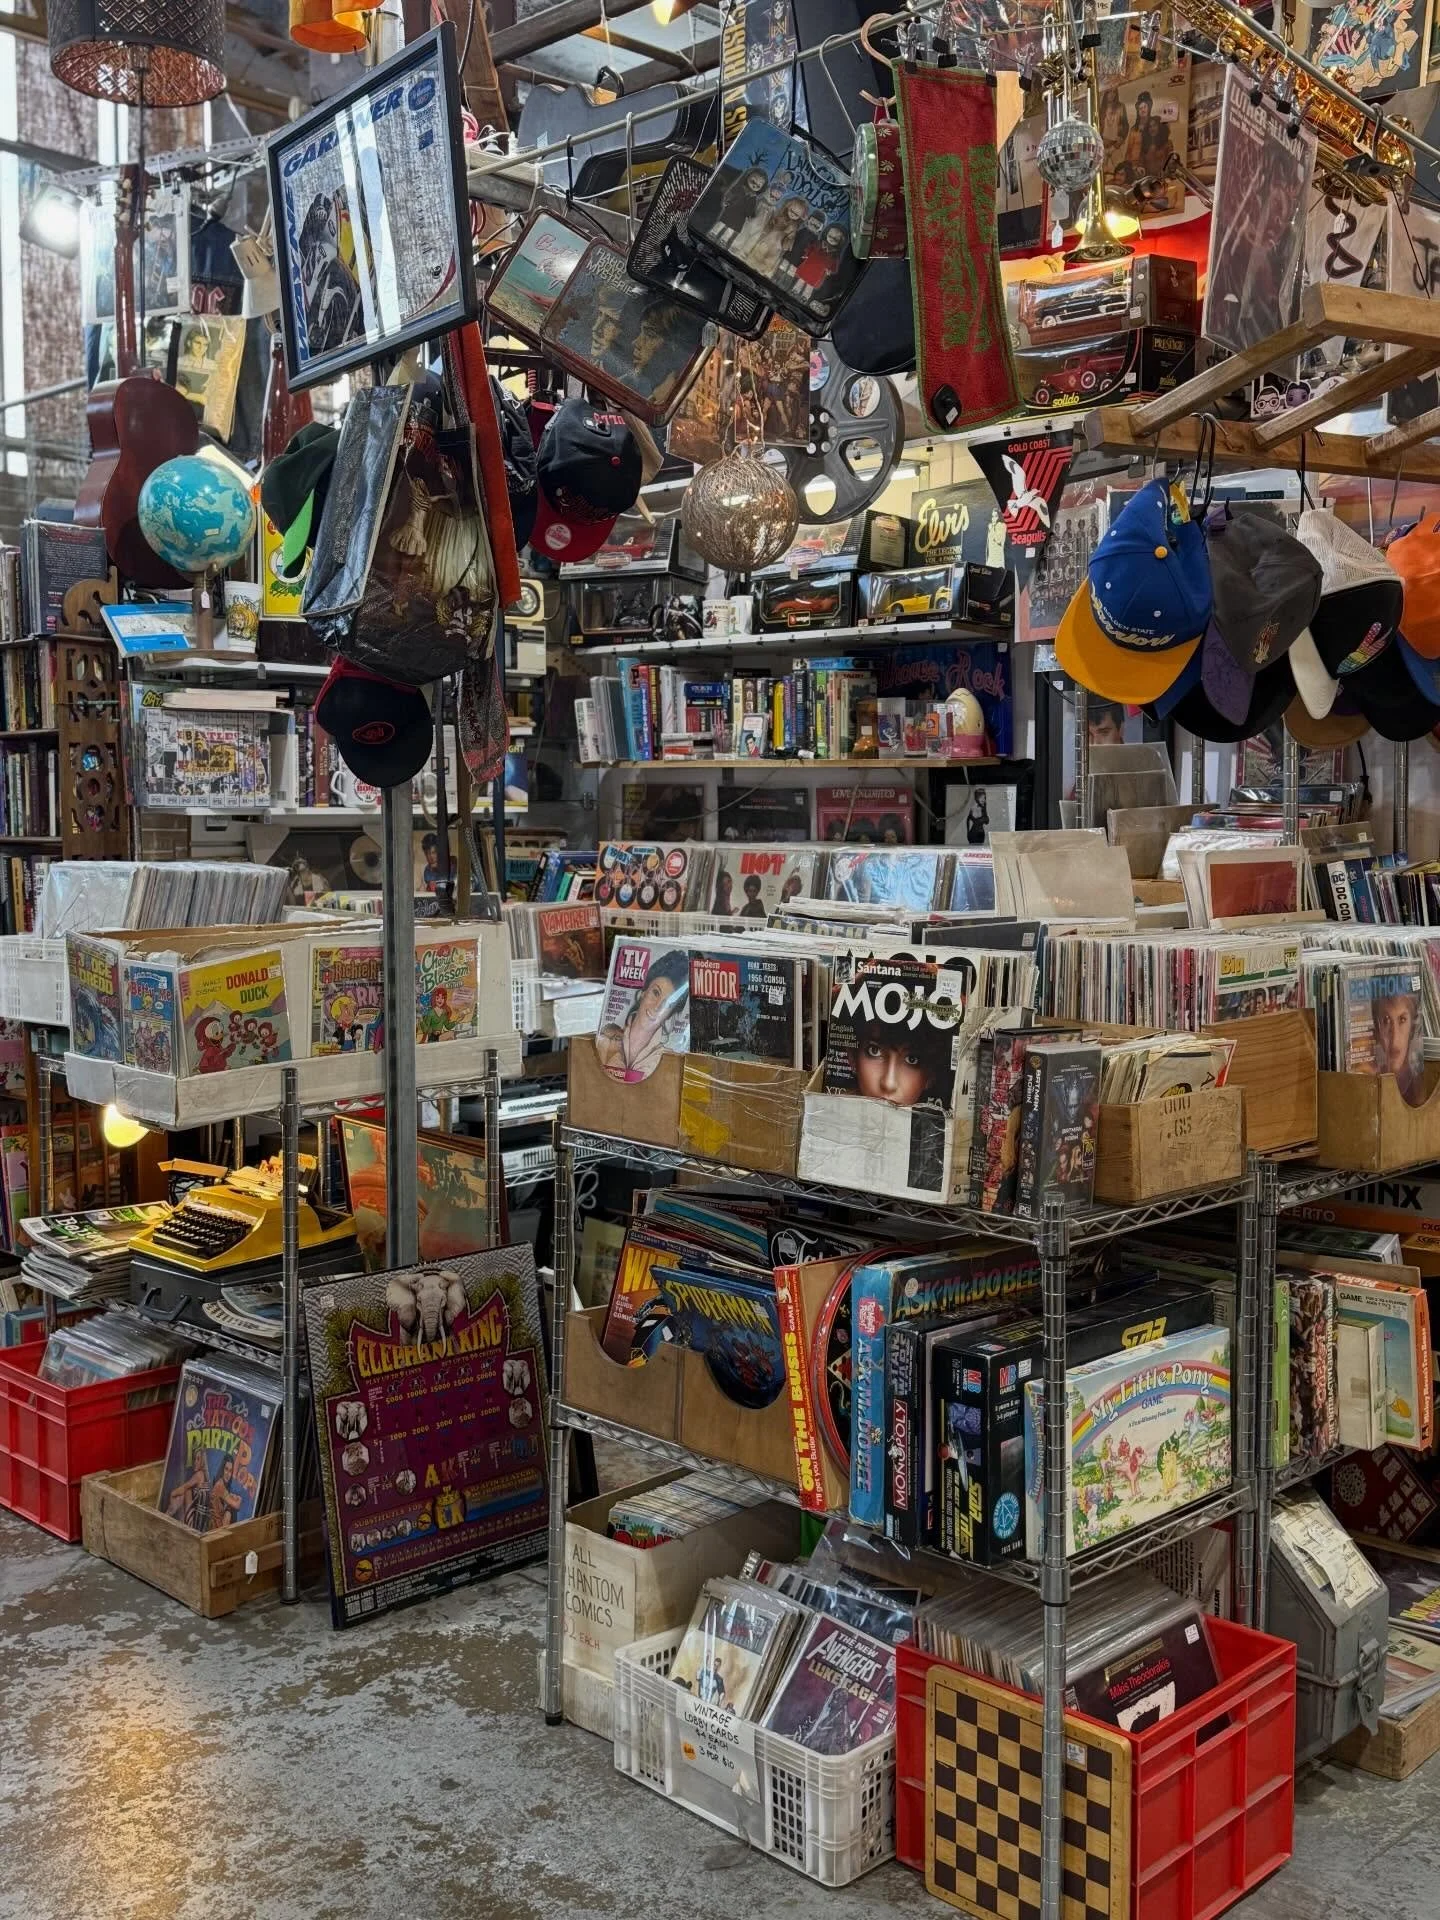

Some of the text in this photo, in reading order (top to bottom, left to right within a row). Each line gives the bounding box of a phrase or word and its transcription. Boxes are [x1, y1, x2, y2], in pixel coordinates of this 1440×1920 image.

[790, 173, 830, 210] DOLLS
[1153, 338, 1186, 351] PRESTIGE
[1052, 393, 1081, 408] solido
[1008, 439, 1028, 451] GOLD
[915, 498, 970, 553] Elvis
[1011, 531, 1046, 546] Seagulls
[1103, 606, 1155, 635] GOLDEN STATE
[945, 647, 1005, 700] Rock
[832, 788, 855, 799] LOVE
[739, 852, 786, 876] HOT
[1336, 886, 1348, 900] DC
[421, 948, 457, 973] Cheryl
[622, 949, 648, 966] TV
[693, 959, 720, 969] modern
[856, 961, 901, 977] Santana
[1221, 955, 1245, 976] Big
[79, 971, 114, 996] DREDD
[202, 977, 222, 988] WALT
[226, 967, 269, 989] DONALD
[420, 965, 470, 993] Blossom
[620, 966, 645, 981] WEEK
[694, 967, 738, 999] MOTOR
[747, 974, 787, 985] 1956 CONSUL
[239, 984, 270, 1004] DUCK
[747, 984, 760, 992] AND
[831, 980, 964, 1031] MOJO
[1033, 1069, 1042, 1112] BATMAN
[1062, 1126, 1083, 1135] BATMAN
[1018, 1203, 1032, 1215] PG
[615, 1300, 633, 1310] GUIDE
[617, 1294, 629, 1302] THE
[895, 1280, 939, 1319] ASK
[1339, 1292, 1363, 1302] GAME
[615, 1306, 623, 1314] TO
[787, 1305, 797, 1332] GAME
[356, 1317, 504, 1377] ELEPHANT KING
[888, 1331, 901, 1387] STAR
[784, 1332, 803, 1401] BUSES
[857, 1338, 873, 1384] ASK
[898, 1332, 910, 1396] WARS
[386, 1370, 497, 1405] 5000 10000 15000 25000 50000
[967, 1369, 982, 1394] MB
[1000, 1365, 1017, 1387] MB
[1000, 1385, 1016, 1394] GAMES
[1089, 1362, 1213, 1426] My Little Pony
[1141, 1393, 1165, 1409] GAME
[999, 1402, 1010, 1411] years
[1004, 1409, 1019, 1420] players
[390, 1405, 501, 1441] 1000 2000 3000 5000 10000
[792, 1407, 810, 1453] THE
[186, 1428, 242, 1468] PARTY
[894, 1401, 907, 1508] MONOPOLY
[425, 1464, 441, 1489] A
[799, 1457, 815, 1491] ON
[812, 1460, 823, 1494] get you
[968, 1477, 983, 1524] STAR
[615, 1522, 627, 1531] THE
[572, 1543, 598, 1569] ALL
[565, 1564, 625, 1610] HANTOM
[565, 1591, 613, 1629] COMICS
[579, 1631, 600, 1650] EACH
[838, 1632, 879, 1659] THE NEW
[806, 1629, 883, 1683] AVENGERS
[808, 1659, 880, 1706] LUKE CAGE
[1109, 1657, 1171, 1700] Mikis Theodorakis
[693, 1702, 732, 1728] VINTAGE
[684, 1711, 740, 1745] LOBBY CARDS
[707, 1742, 718, 1753] OR
[708, 1734, 729, 1752] EACH
[699, 1746, 735, 1770] 3 FOR $10
